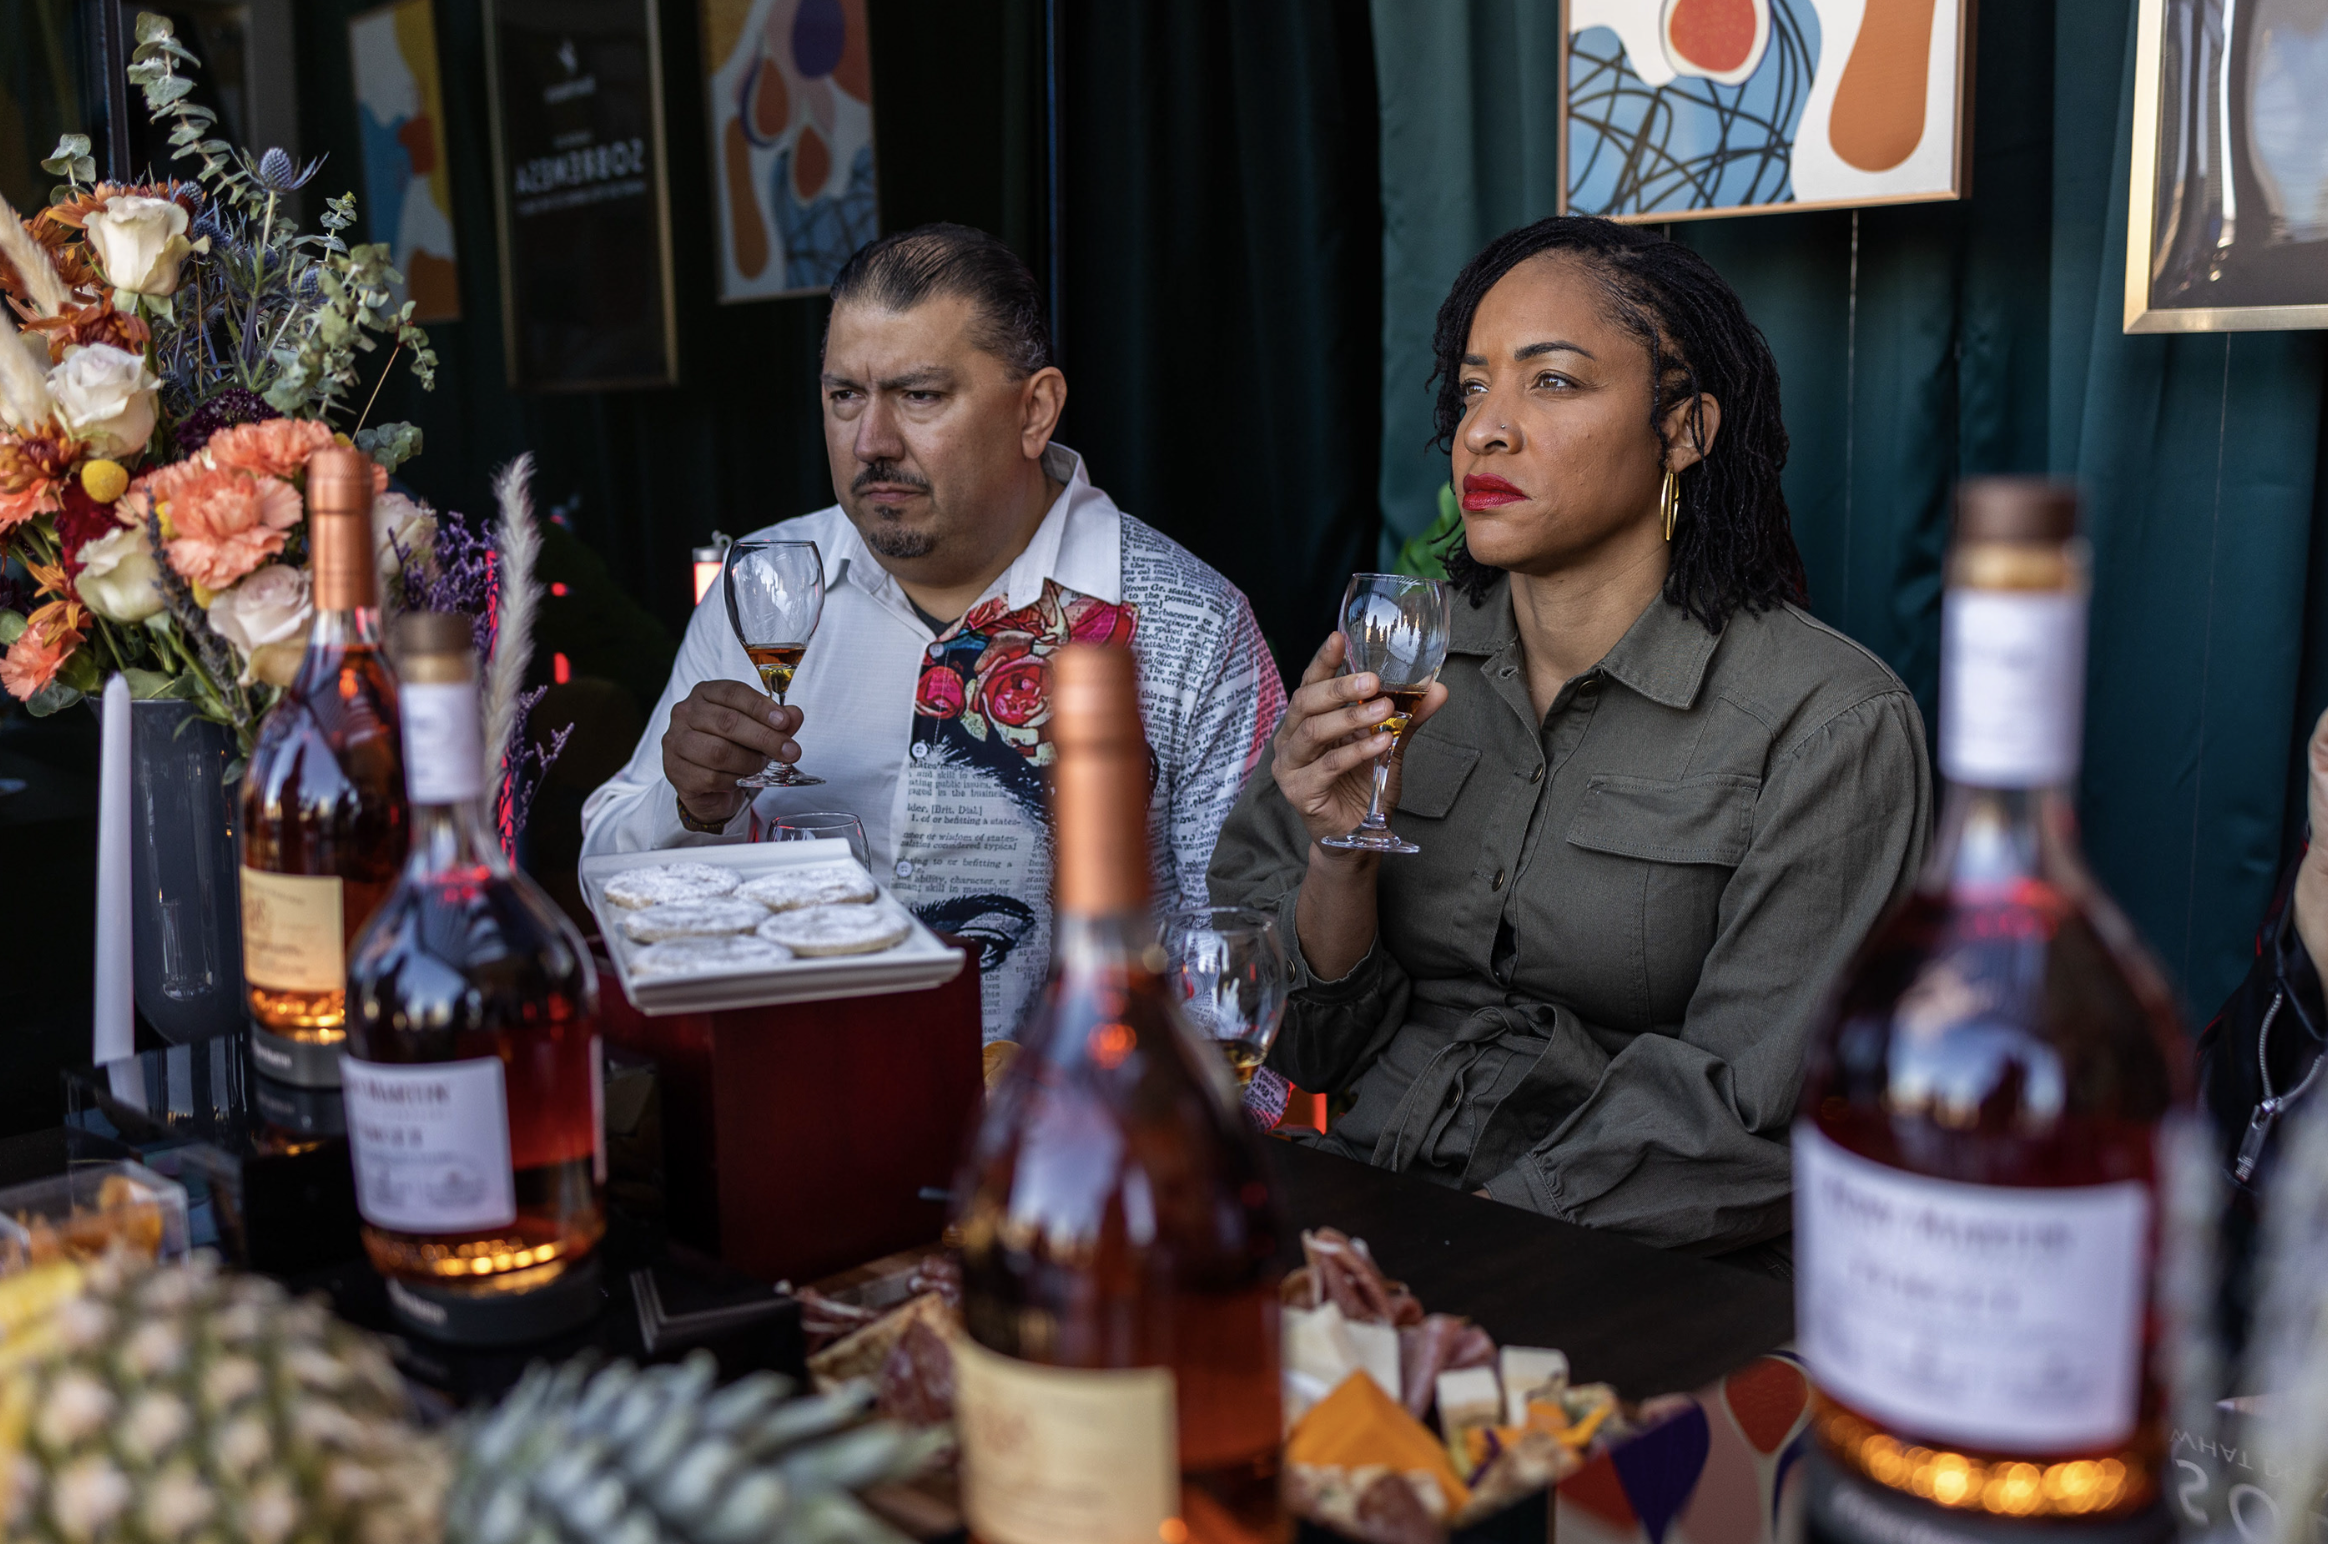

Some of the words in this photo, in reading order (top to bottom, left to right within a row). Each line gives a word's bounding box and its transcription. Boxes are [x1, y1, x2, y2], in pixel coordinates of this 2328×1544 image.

[1128, 592, 1139, 600] to
[1144, 591, 1160, 600] the
[1164, 594, 1205, 609] powerful
[1165, 634, 1181, 644] the
[1144, 640, 1182, 653] attached
[1184, 646, 1195, 655] to
[951, 788, 967, 798] the
[920, 814, 931, 824] of
[932, 816, 943, 824] or
[943, 815, 981, 826] befitting
[932, 840, 981, 850] considered
[983, 841, 1018, 852] typical
[933, 857, 944, 866] to
[962, 857, 1003, 869] befitting
[925, 882, 945, 894] skill
[949, 883, 959, 894] in
